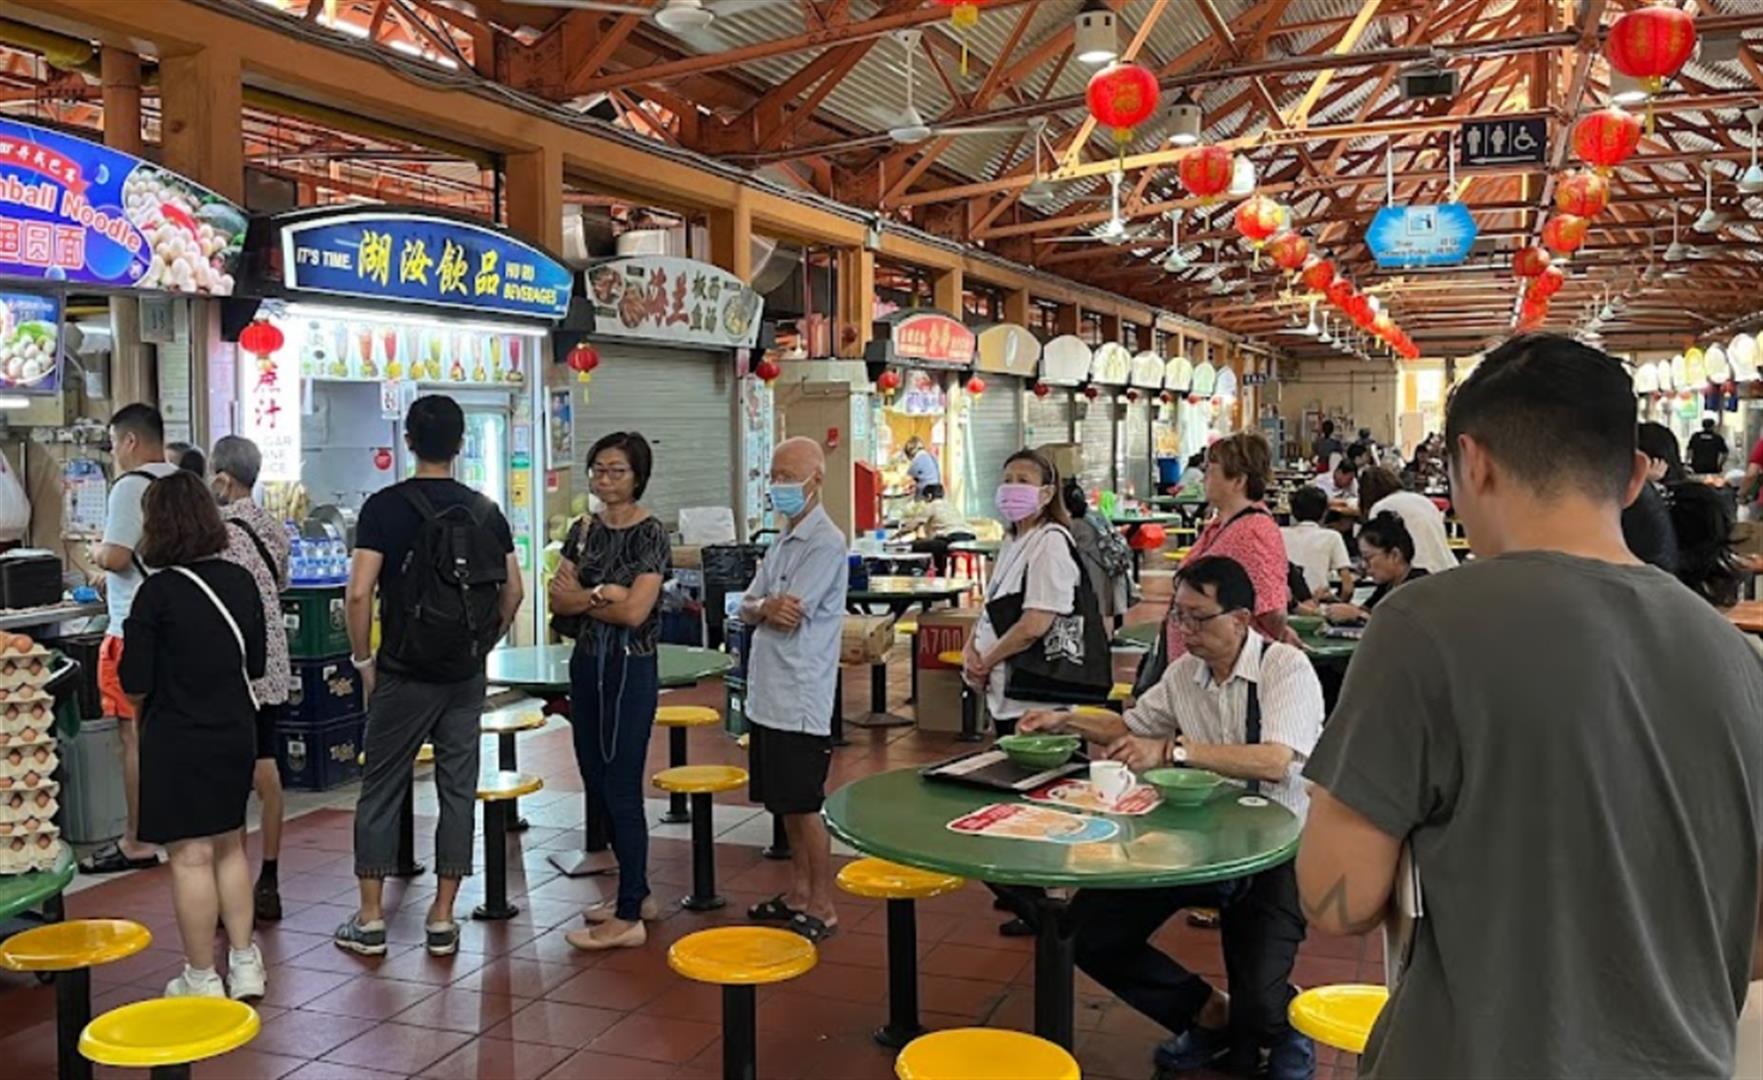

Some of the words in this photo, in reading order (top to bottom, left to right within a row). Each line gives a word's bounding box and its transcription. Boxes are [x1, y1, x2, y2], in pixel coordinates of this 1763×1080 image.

[60, 189, 142, 255] Noodle
[296, 246, 320, 266] IT'S
[503, 282, 558, 306] BEVERAGES
